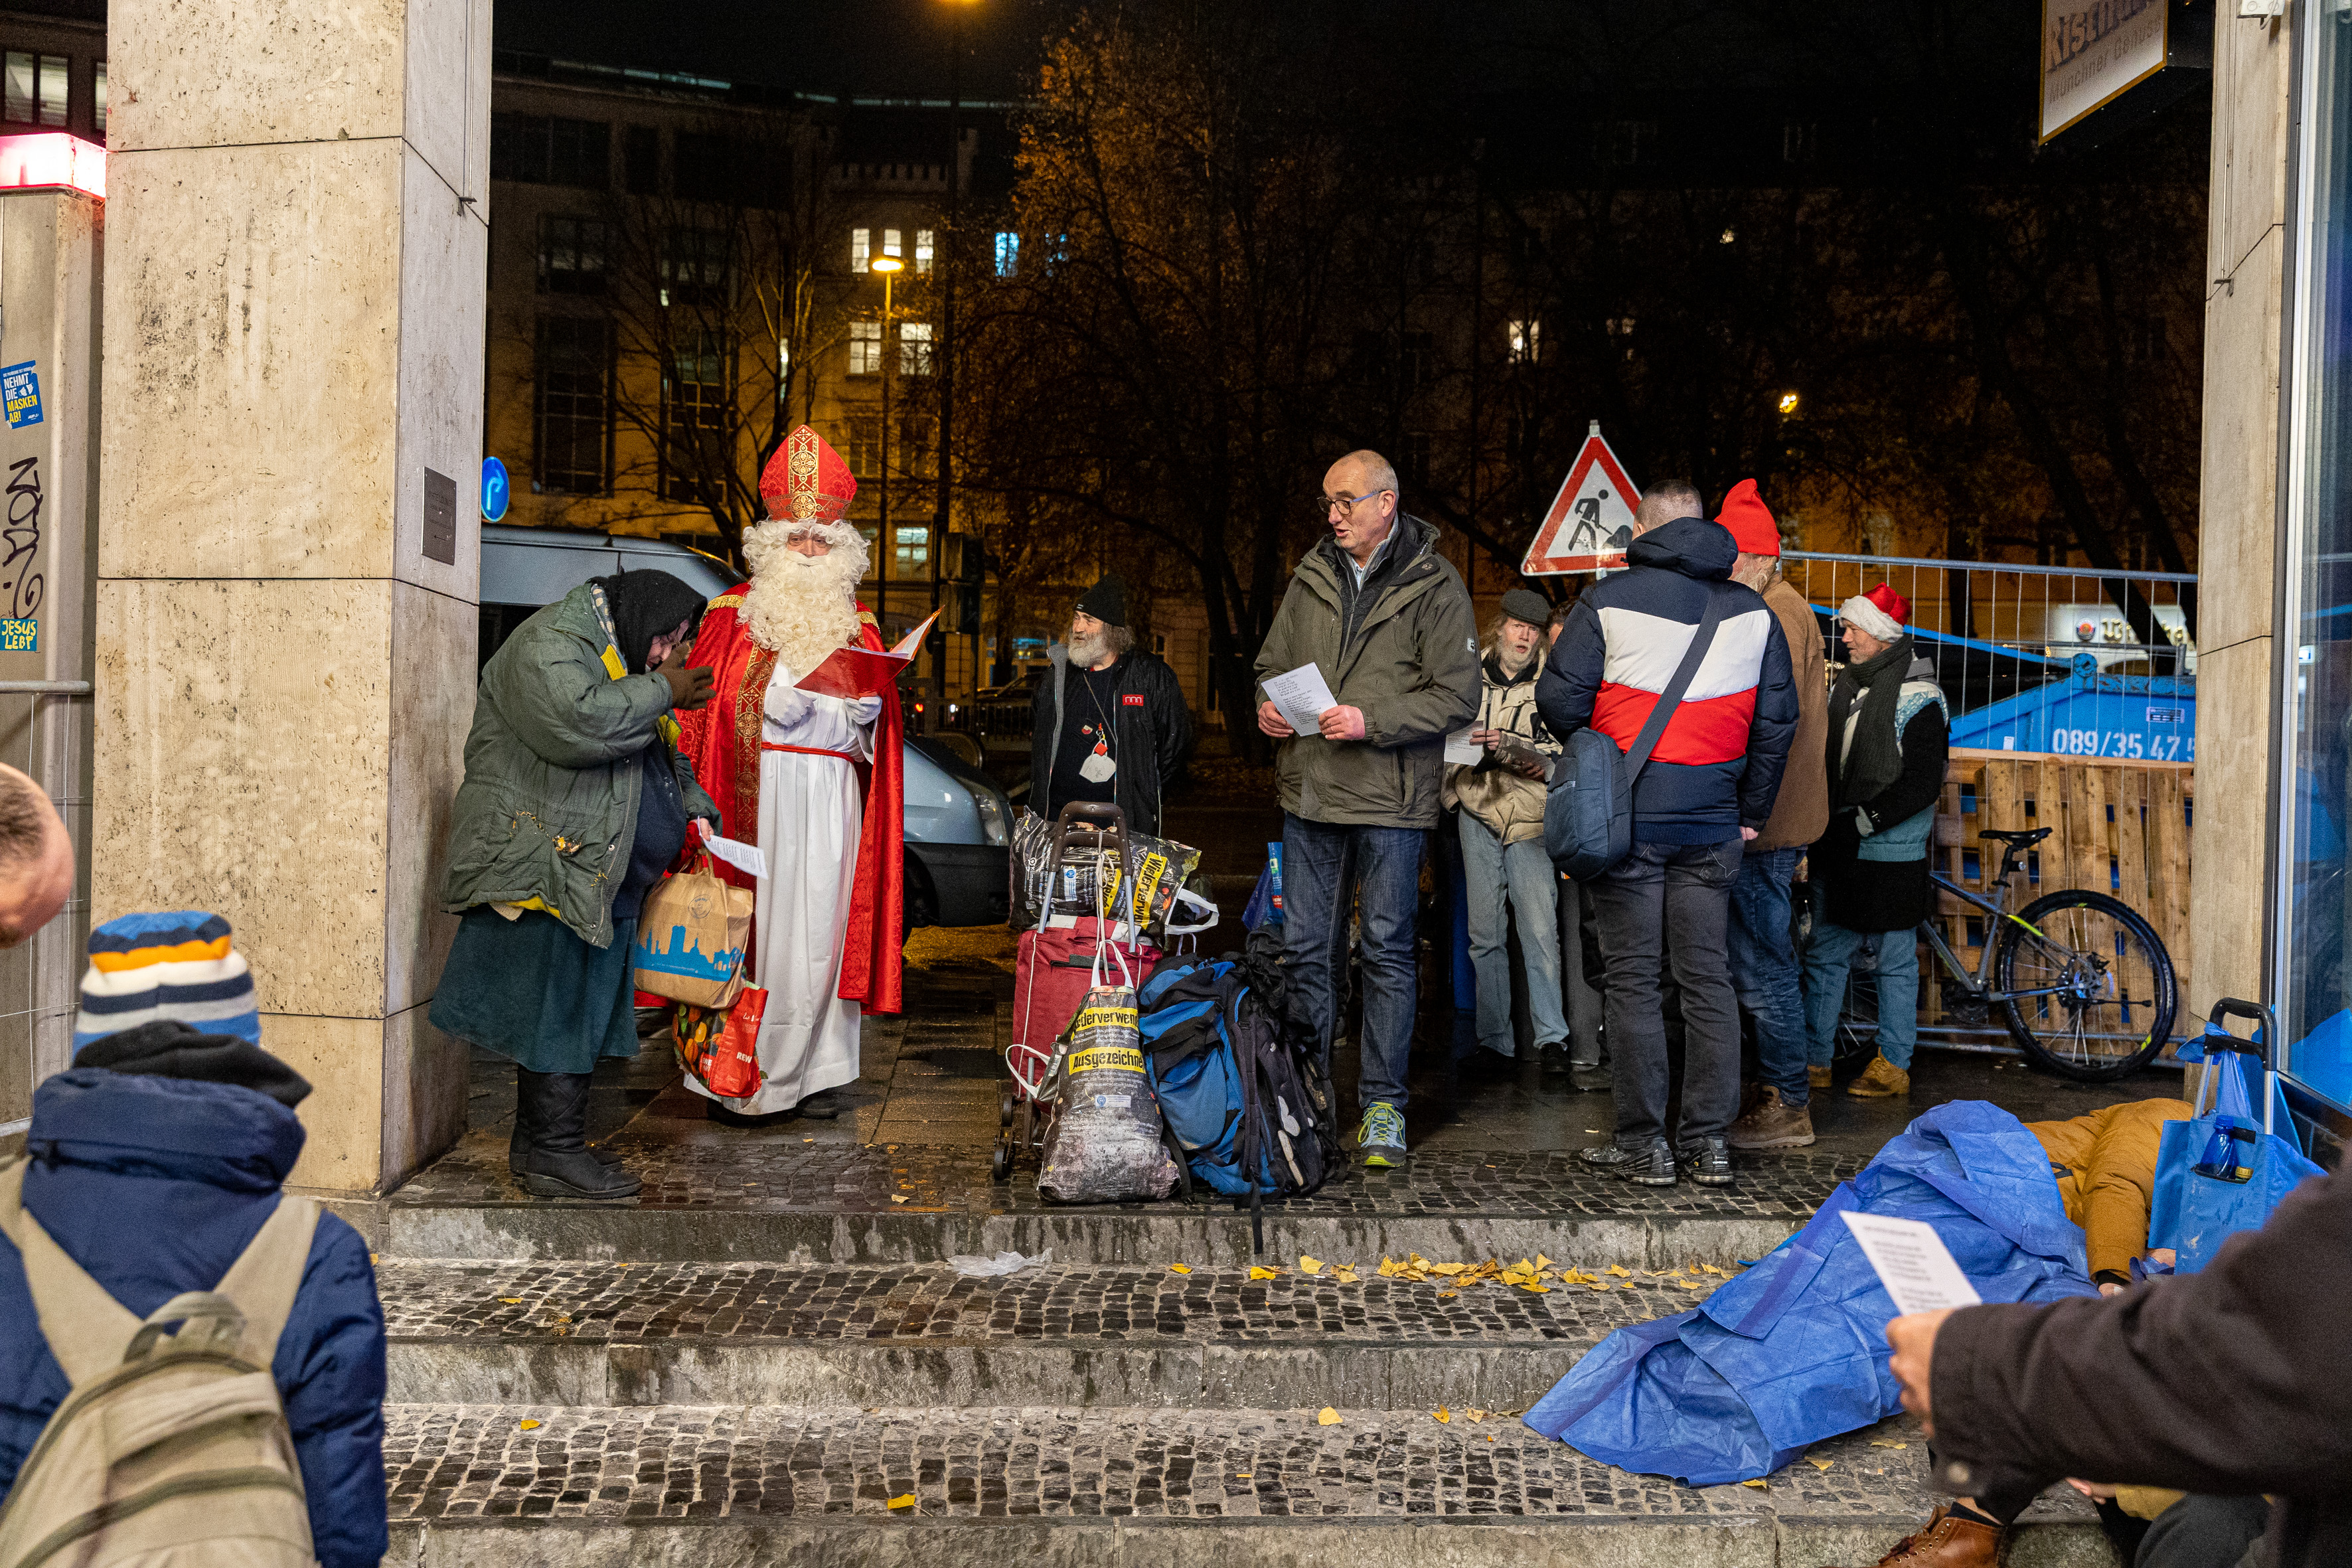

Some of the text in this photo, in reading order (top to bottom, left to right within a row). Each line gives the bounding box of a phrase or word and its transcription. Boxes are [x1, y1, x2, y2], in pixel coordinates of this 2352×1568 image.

[3, 373, 29, 390] NEHMT
[5, 388, 18, 401] DIE
[7, 394, 38, 412] MASKEN
[9, 410, 21, 423] AB!
[1, 619, 36, 637] JESUS
[5, 635, 34, 650] LEBT
[2053, 728, 2144, 759] 089/35
[2150, 735, 2181, 761] 47
[1073, 1050, 1144, 1070] Ausgezeichne
